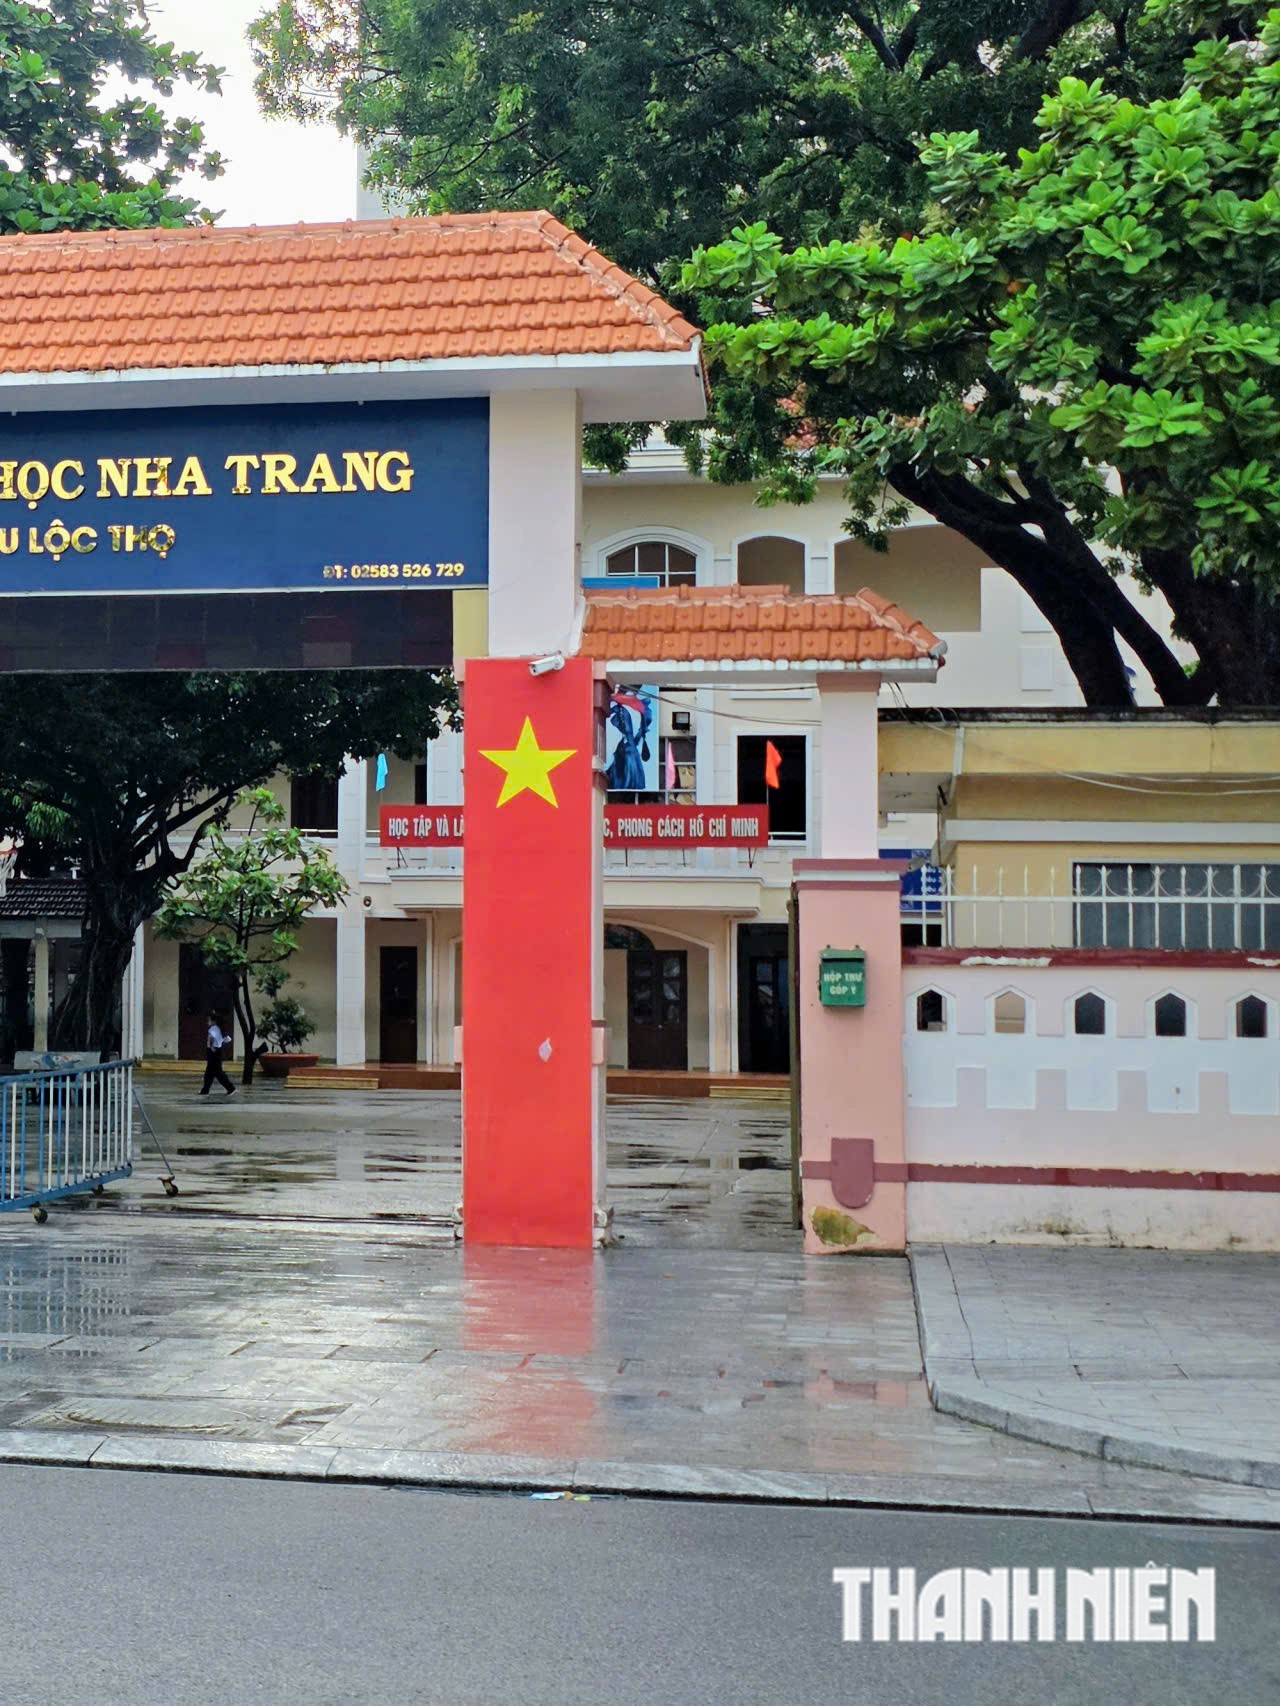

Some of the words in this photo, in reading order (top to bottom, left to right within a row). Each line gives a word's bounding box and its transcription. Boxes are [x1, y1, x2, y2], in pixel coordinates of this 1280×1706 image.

[95, 455, 214, 499] NHA
[224, 450, 415, 495] TRANG
[28, 518, 98, 562] LỘC
[107, 523, 176, 560] THỌ
[322, 564, 348, 579] ĐT:
[351, 564, 399, 579] 02583
[402, 563, 432, 578] 526
[435, 563, 465, 577] 729
[388, 817, 409, 840] HỌC
[413, 814, 432, 839] TẬP
[436, 814, 450, 837] VÀ
[453, 814, 464, 837] LÀ
[618, 818, 653, 837] PHONG
[657, 815, 685, 837] CÁCH
[708, 814, 727, 837] CHÍ
[731, 817, 759, 837] MINH
